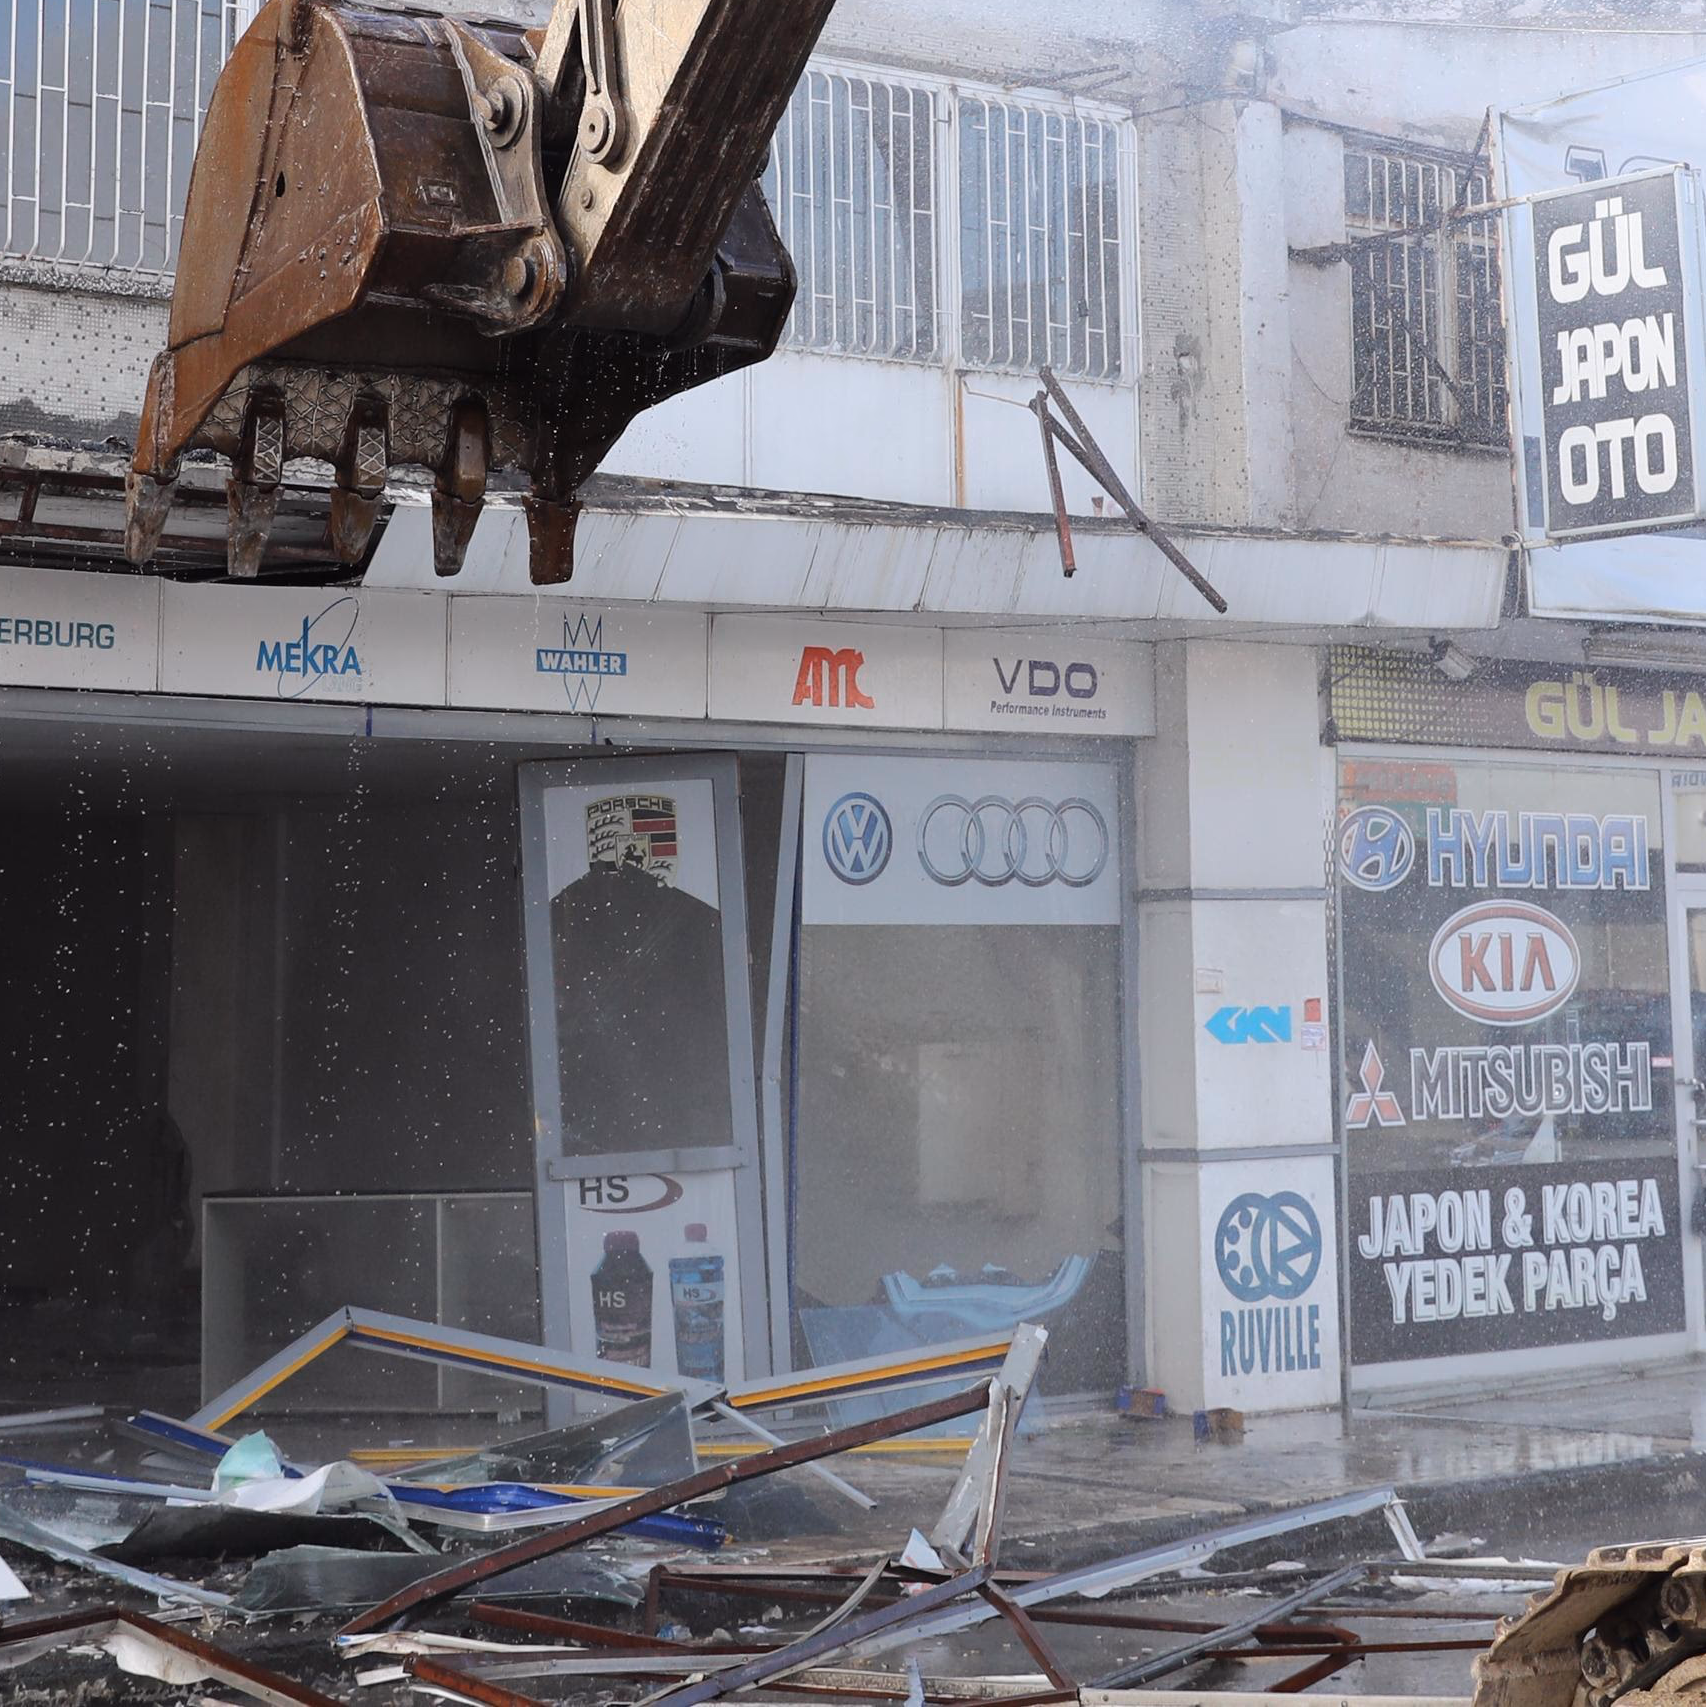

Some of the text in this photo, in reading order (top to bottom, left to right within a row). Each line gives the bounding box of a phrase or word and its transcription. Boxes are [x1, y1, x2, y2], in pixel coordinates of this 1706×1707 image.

[1546, 197, 1669, 305] GÜL
[1552, 311, 1677, 408] JAPON
[1558, 412, 1679, 505] OTO
[256, 614, 362, 678] MEKRA
[540, 650, 624, 675] WAHLER
[993, 657, 1098, 699] VDO
[990, 700, 1107, 720] Performance Instruments
[1525, 671, 1639, 746] GÜL
[587, 796, 676, 818] PORSCHE
[1427, 806, 1652, 892] HYUNDAI
[1458, 931, 1556, 993] KIA
[1410, 1041, 1653, 1123] MITSUBISHI
[579, 1175, 630, 1206] HS
[1358, 1177, 1665, 1261] JAPON & KOREA
[599, 1291, 627, 1309] HS
[683, 1288, 700, 1300] HS
[1382, 1242, 1648, 1325] YEDEK PARÇA
[1220, 1304, 1322, 1378] RUVILLE
